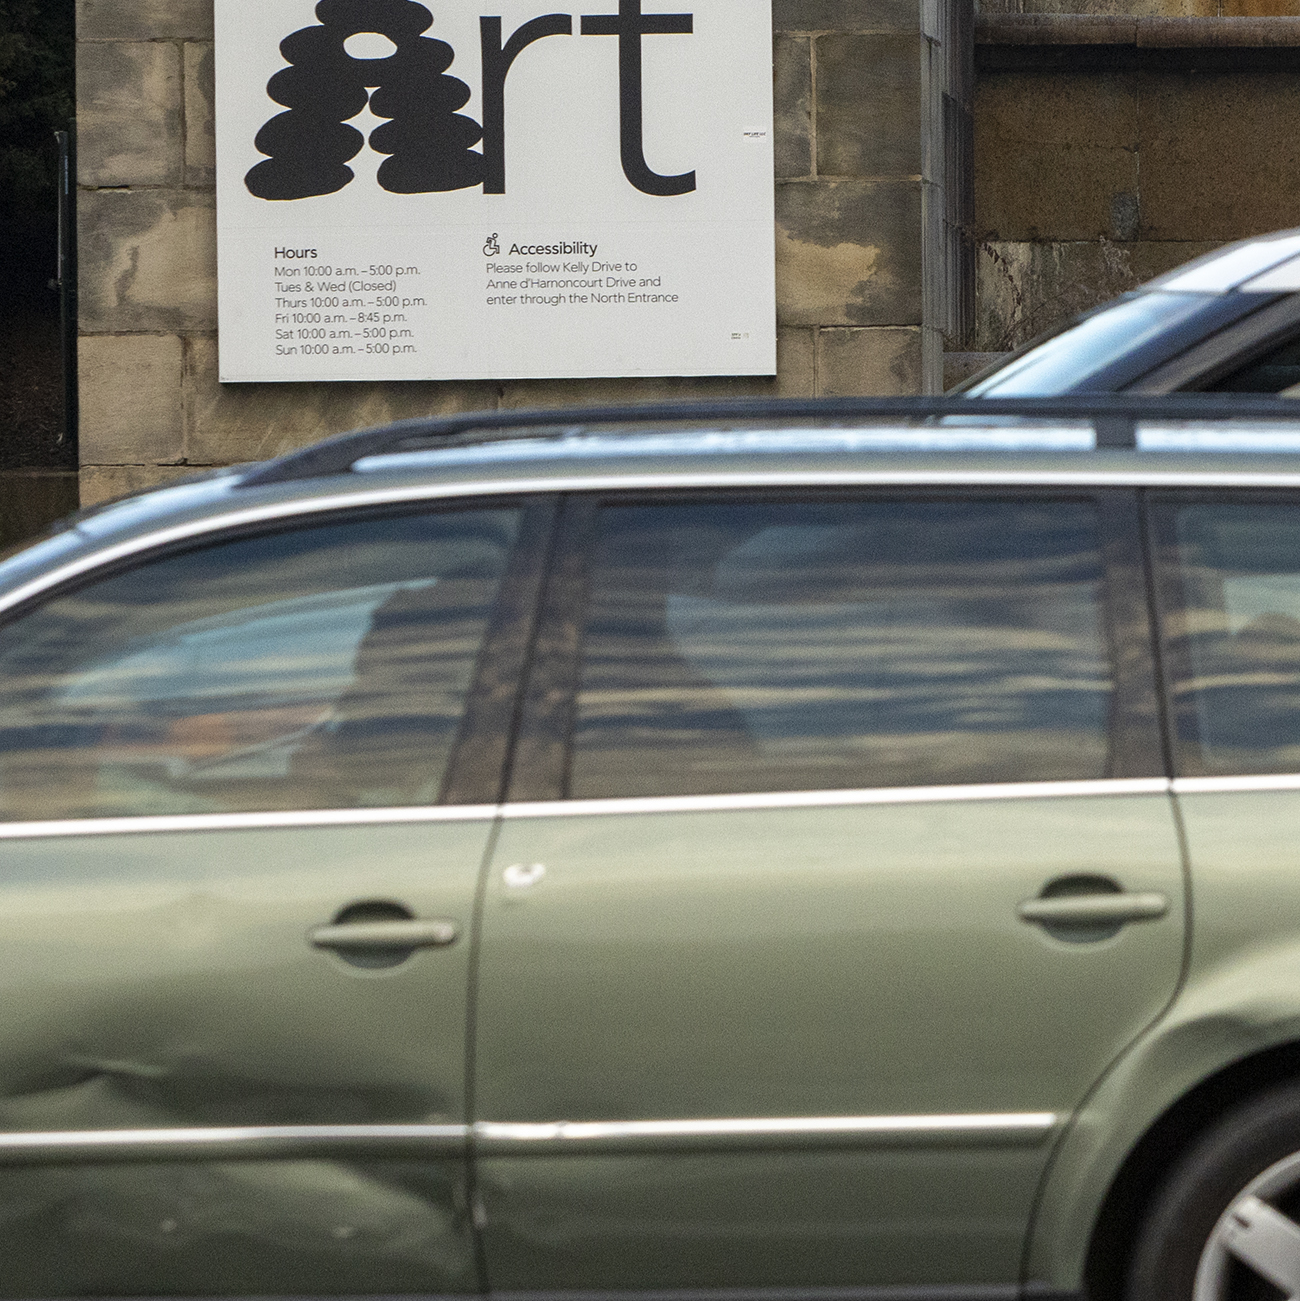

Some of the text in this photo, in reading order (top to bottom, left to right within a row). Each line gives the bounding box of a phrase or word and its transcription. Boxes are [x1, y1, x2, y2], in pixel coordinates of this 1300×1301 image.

[274, 246, 317, 260] Hours
[507, 240, 597, 259] Accessibility
[274, 266, 301, 278] Mon
[303, 265, 333, 277] 10:00
[395, 266, 420, 278] p.m.
[485, 260, 637, 275] Please follow Kelly Drive to
[274, 279, 396, 294] Tues & Wed (Closed)
[485, 278, 518, 290] Anne
[605, 275, 637, 289] Drive
[638, 275, 661, 288] and
[274, 297, 308, 309] Thurs
[309, 296, 339, 309] 10:00
[401, 297, 427, 309] p.m.
[485, 292, 679, 306] enter through the North Entrance
[274, 312, 289, 324] Fri
[291, 312, 321, 325] 10:00
[382, 313, 407, 325] p.m.
[275, 328, 293, 341] Sat
[296, 327, 326, 340] 10:00
[388, 328, 413, 340] p.m.
[275, 343, 297, 357] Sun
[299, 343, 330, 356] 10:00
[392, 344, 417, 356] p.m.
